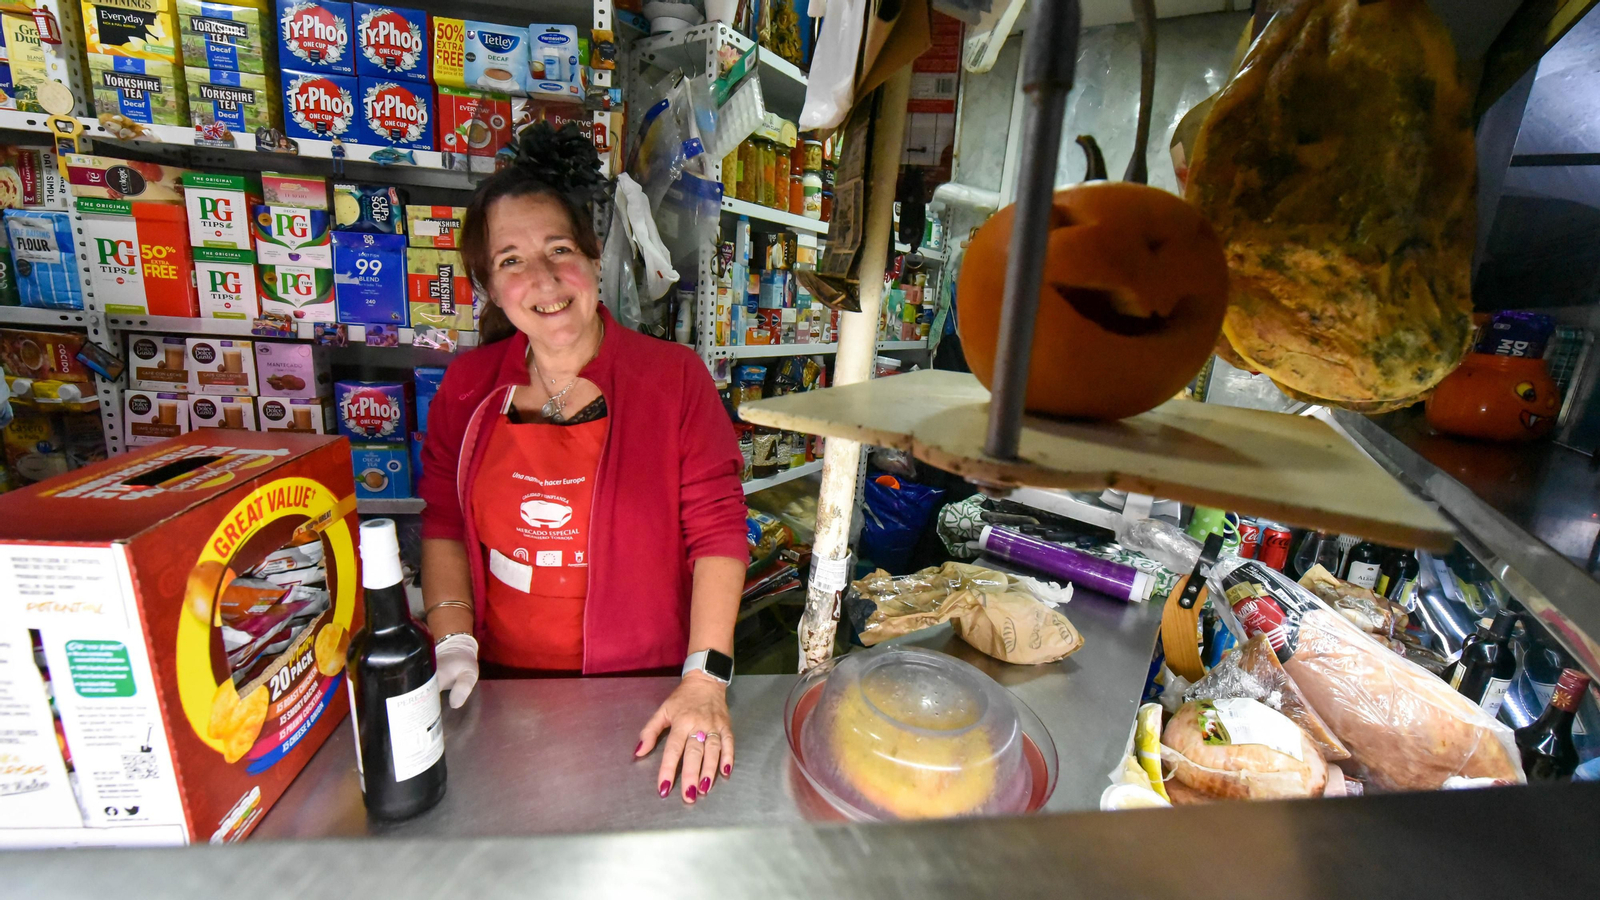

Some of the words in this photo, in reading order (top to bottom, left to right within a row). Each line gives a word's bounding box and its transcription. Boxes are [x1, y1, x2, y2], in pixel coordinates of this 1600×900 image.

[100, 10, 144, 26] Everyday
[19, 24, 40, 36] Gra
[192, 18, 246, 37] YORKSHIRE
[436, 22, 464, 42] 50%
[14, 32, 41, 46] Duq
[210, 33, 229, 44] TEA
[437, 41, 464, 50] EXTRA
[482, 33, 514, 49] Tetley
[210, 46, 231, 54] Decaf
[437, 50, 464, 67] FREE
[488, 54, 508, 62] DECAF
[104, 74, 160, 91] YORKSHIRE
[124, 88, 142, 99] TEA
[200, 86, 253, 103] YORKSHIRE
[124, 100, 145, 108] Decaf
[218, 100, 237, 110] TEA
[42, 154, 52, 168] OAT
[46, 176, 54, 202] SIMPLE
[96, 202, 129, 210] ORIGINAL
[197, 197, 234, 221] PG
[372, 196, 380, 222] SOUP
[275, 213, 308, 237] PG
[26, 230, 50, 239] RAISING
[17, 237, 50, 252] FLOUR
[94, 238, 137, 266] PG
[141, 244, 176, 259] 50%
[100, 266, 127, 274] TIPS
[355, 259, 382, 276] 99
[207, 270, 243, 294] PG
[280, 273, 312, 295] PG
[430, 282, 439, 297] TEA
[440, 266, 450, 314] YORKSHIRE
[58, 344, 69, 373] COCIDO
[563, 477, 585, 485] Europa
[214, 496, 264, 558] GREAT
[516, 527, 547, 535] MERCADO
[270, 666, 290, 702] 20
[290, 650, 314, 681] PACK
[283, 690, 299, 708] ROAST
[298, 666, 318, 694] CHICKEN
[286, 701, 303, 720] SMOKY
[301, 680, 318, 705] BACON
[286, 713, 303, 734] PRAWN
[302, 690, 323, 716] COCKTAIL
[289, 726, 307, 747] CHEESE
[310, 701, 324, 723] ONION
